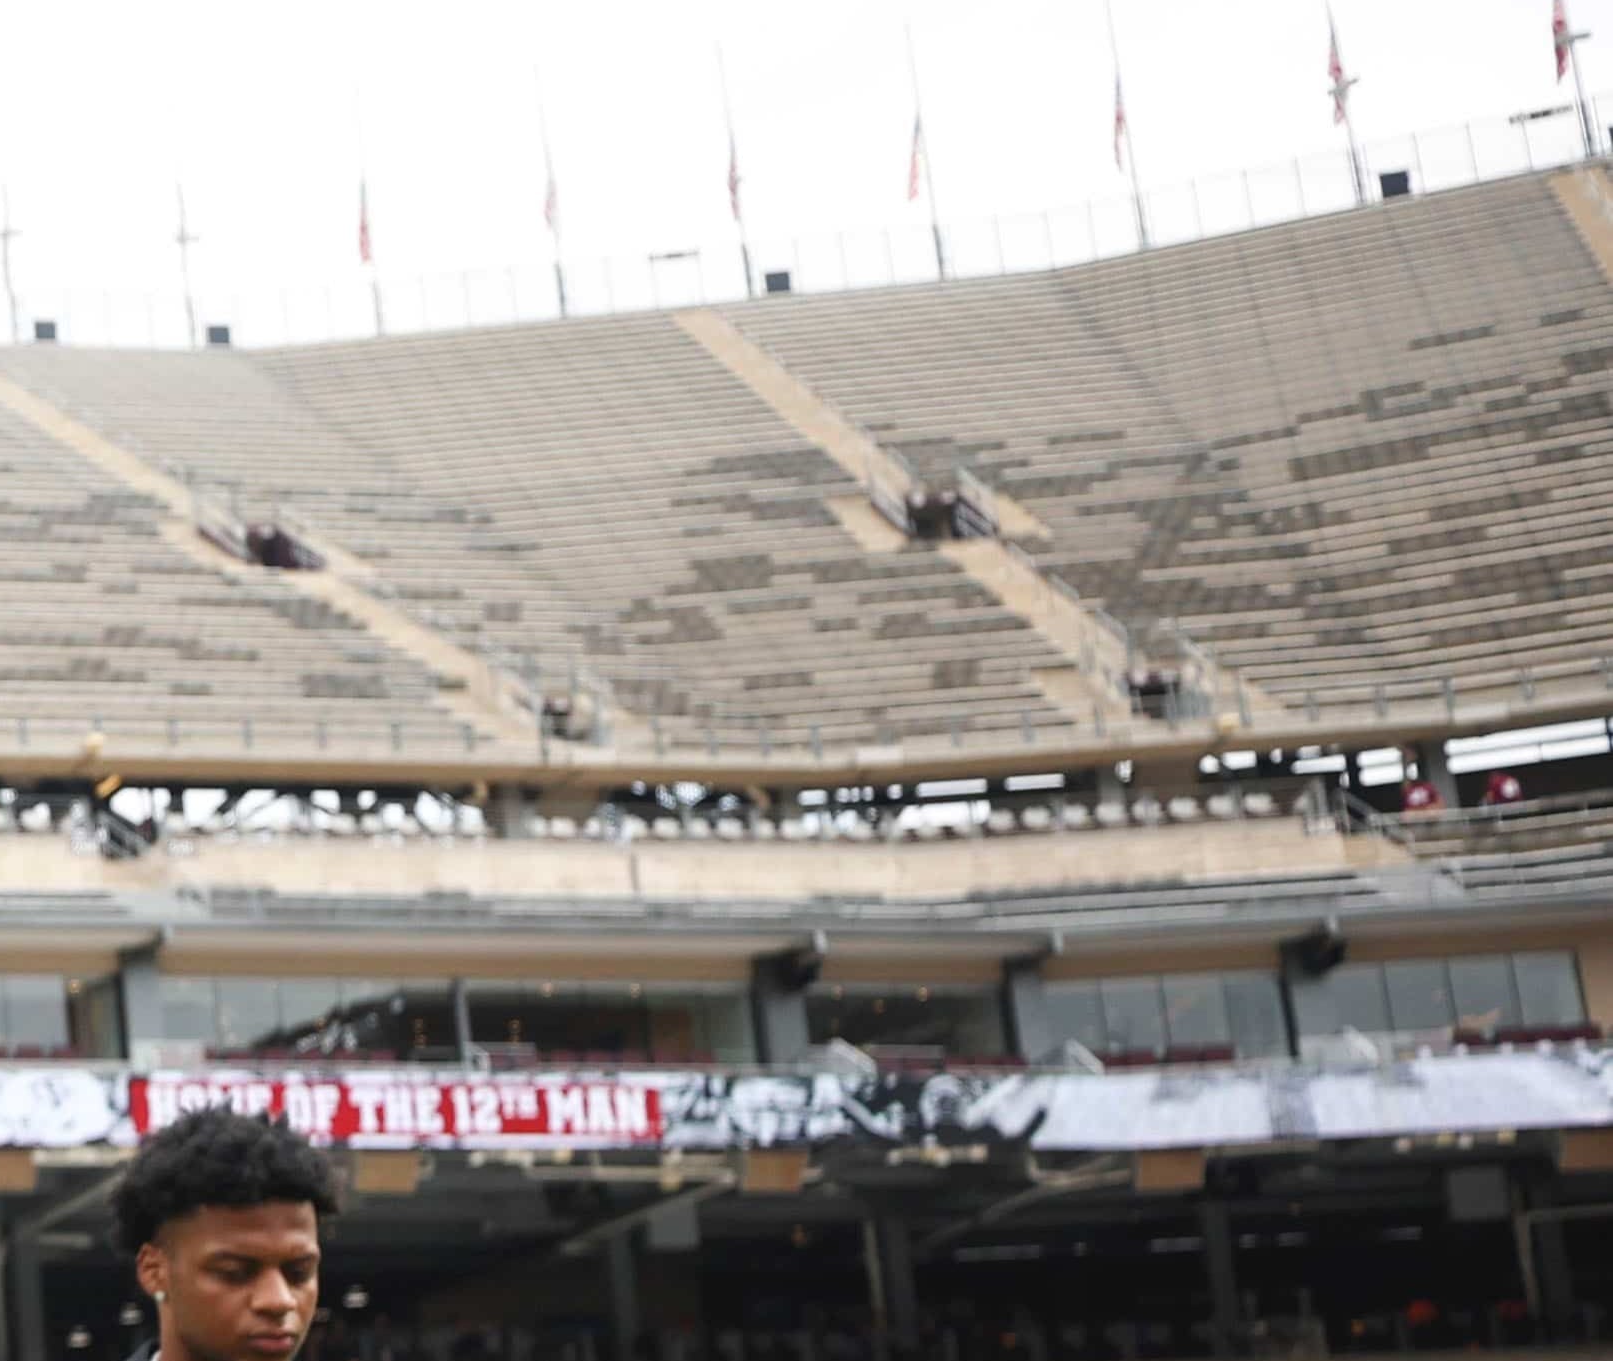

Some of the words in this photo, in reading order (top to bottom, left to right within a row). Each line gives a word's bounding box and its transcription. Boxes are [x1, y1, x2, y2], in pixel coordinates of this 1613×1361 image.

[285, 1084, 340, 1134] OF
[349, 1085, 444, 1134] THE
[545, 1085, 648, 1136] MAN
